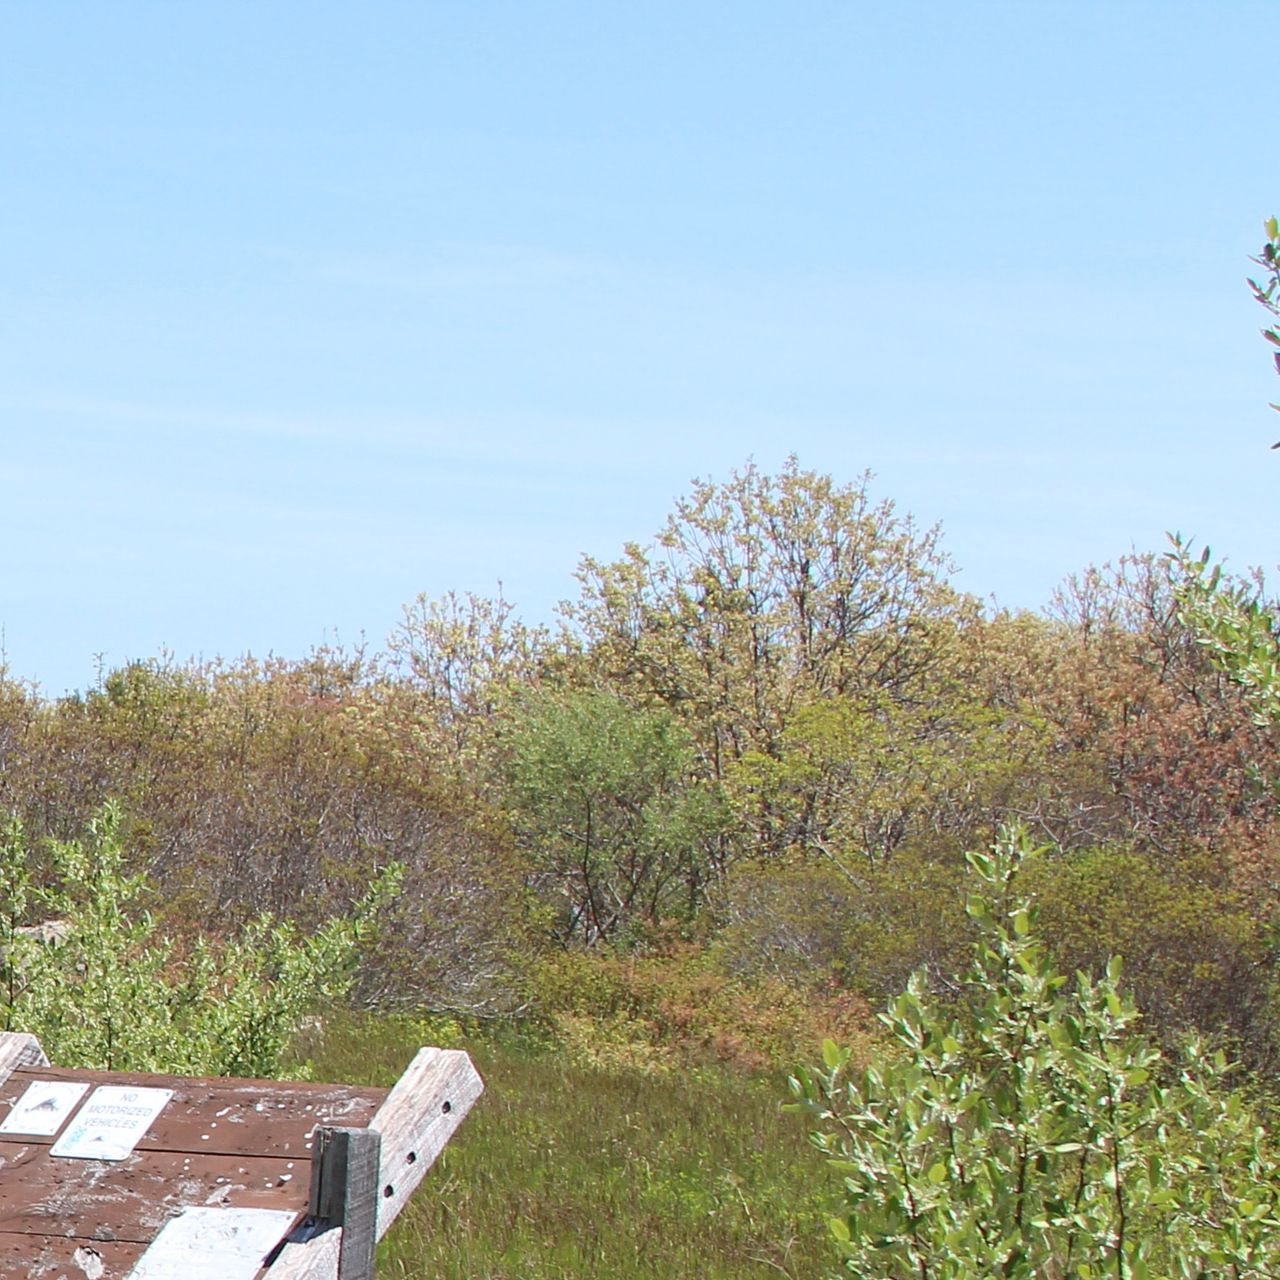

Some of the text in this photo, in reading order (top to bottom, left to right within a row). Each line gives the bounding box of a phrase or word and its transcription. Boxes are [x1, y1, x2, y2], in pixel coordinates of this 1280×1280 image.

[120, 1093, 139, 1103] NO
[87, 1104, 153, 1117] MOTORIZED
[84, 1117, 139, 1129] VEHICLES
